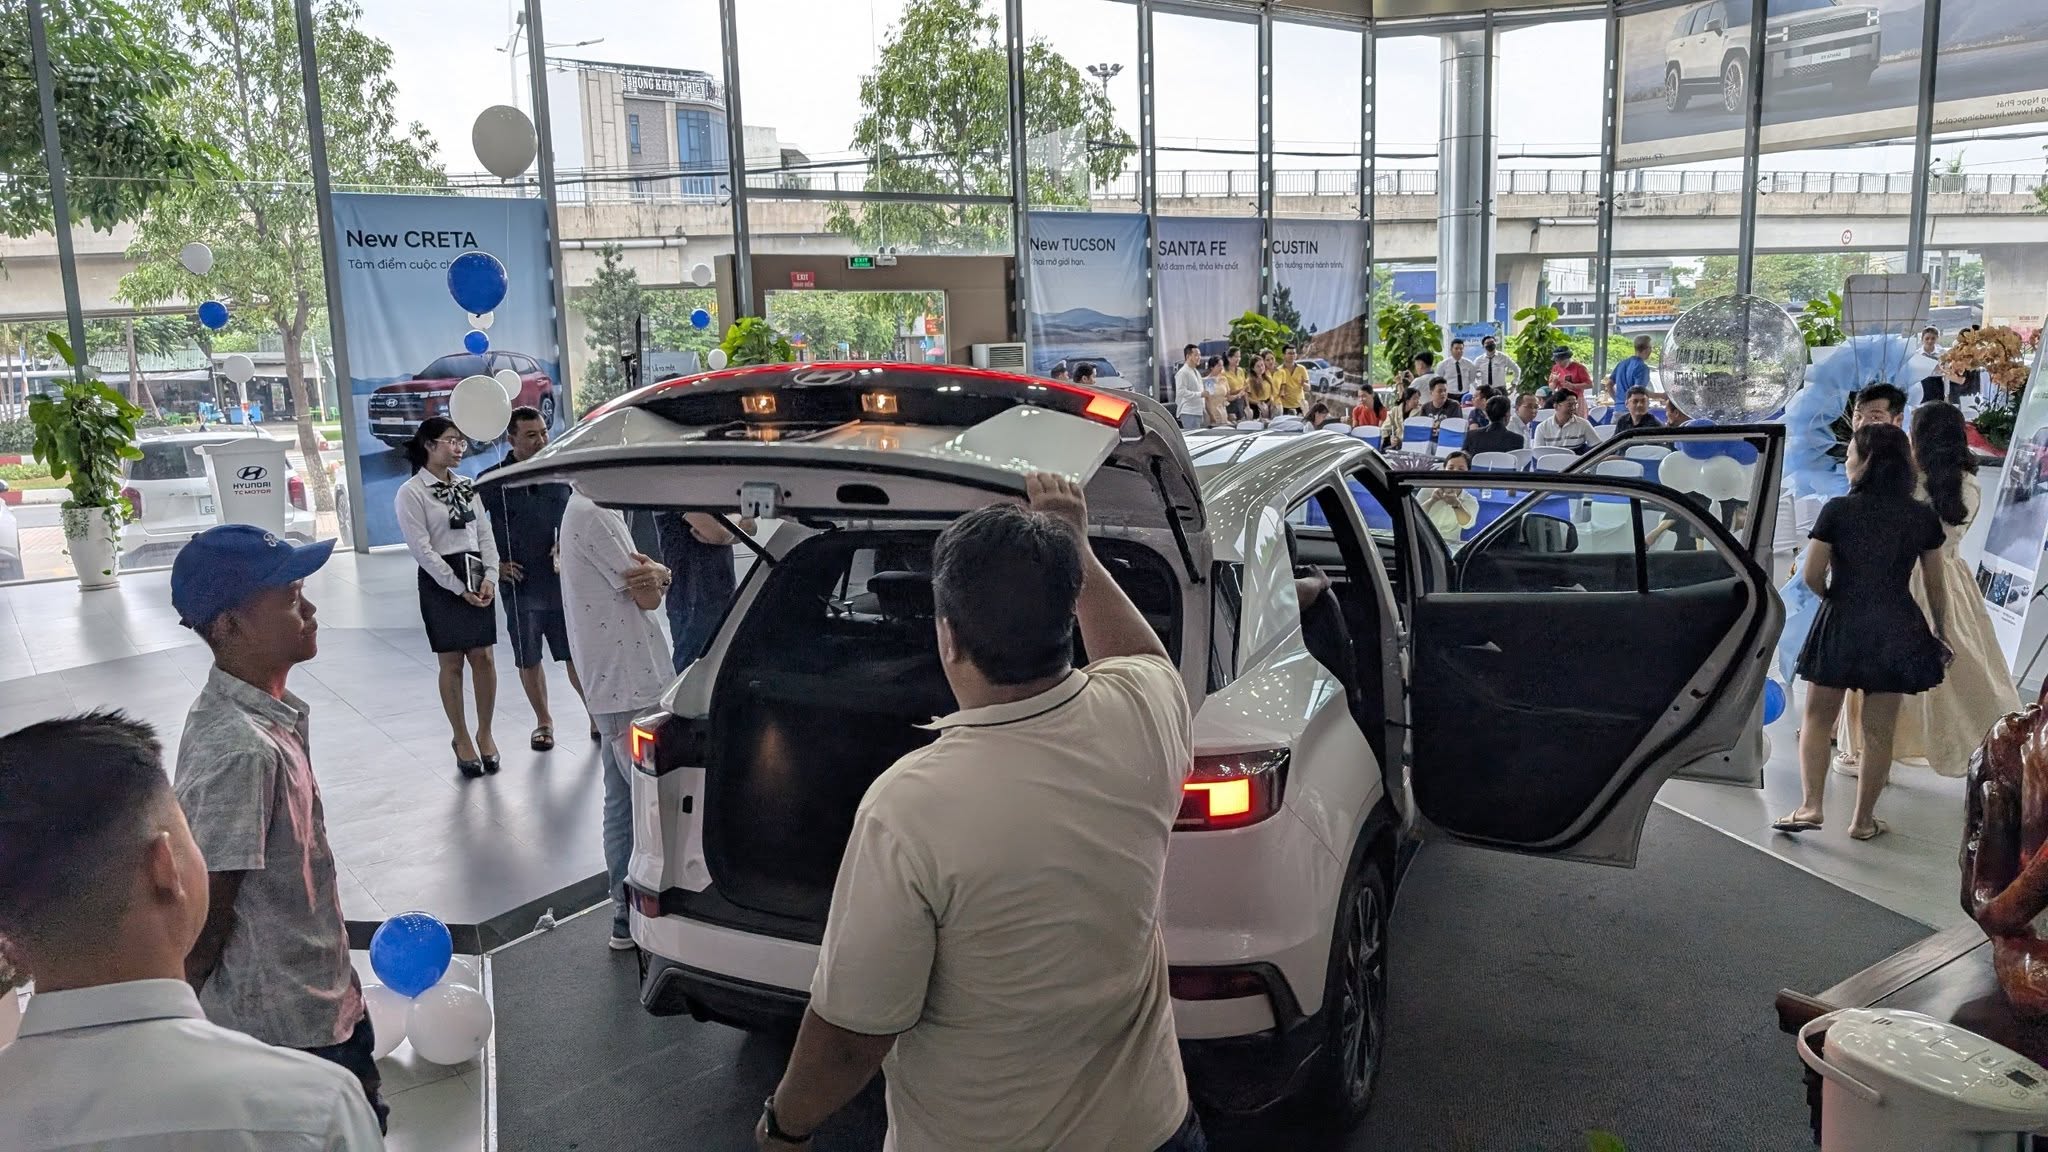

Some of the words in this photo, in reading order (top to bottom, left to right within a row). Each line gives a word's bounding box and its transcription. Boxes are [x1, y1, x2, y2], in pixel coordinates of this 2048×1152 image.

[346, 230, 398, 248] New
[404, 230, 478, 248] CRETA
[1030, 238, 1060, 251] New
[1062, 238, 1116, 251] TUCSON
[1158, 240, 1207, 256] SANTA
[1210, 240, 1227, 256] FE
[1272, 240, 1318, 254] CUSTIN
[348, 258, 375, 269] Tâm
[378, 257, 407, 269] điểm
[409, 259, 437, 271] cuộc
[796, 273, 809, 281] EXIT
[233, 481, 271, 489] HYUNDAI
